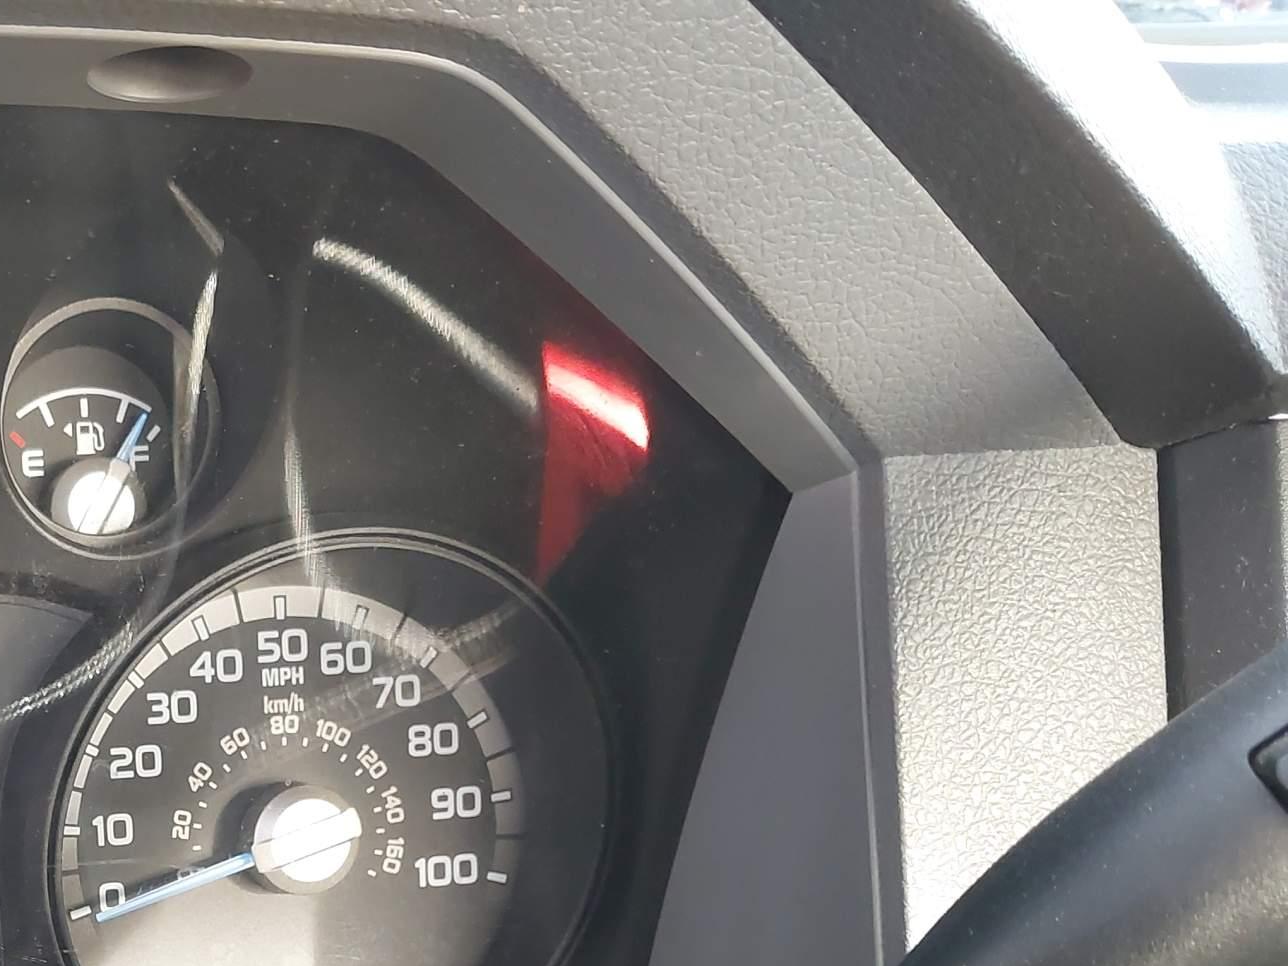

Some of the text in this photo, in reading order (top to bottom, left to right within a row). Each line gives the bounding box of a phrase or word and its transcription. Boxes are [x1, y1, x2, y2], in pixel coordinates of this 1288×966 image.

[22, 449, 44, 477] E
[129, 445, 149, 472] F
[257, 628, 308, 662] 50
[320, 640, 372, 675] 60
[190, 649, 243, 684] 40
[261, 666, 305, 687] MPH
[147, 690, 198, 725] 30
[263, 693, 305, 714] km/h
[373, 674, 421, 708] 70
[220, 727, 250, 755] 60
[270, 714, 300, 735] 80
[316, 718, 351, 747] 100
[408, 722, 459, 757] 80
[110, 744, 162, 779] 20
[187, 762, 212, 793] 40
[356, 744, 388, 779] 120
[381, 786, 405, 824] 140
[431, 785, 482, 820] 90
[92, 812, 134, 847] 10
[172, 809, 192, 840] 20
[382, 837, 405, 874] 160
[414, 853, 479, 888] 100
[99, 882, 126, 912] 0
